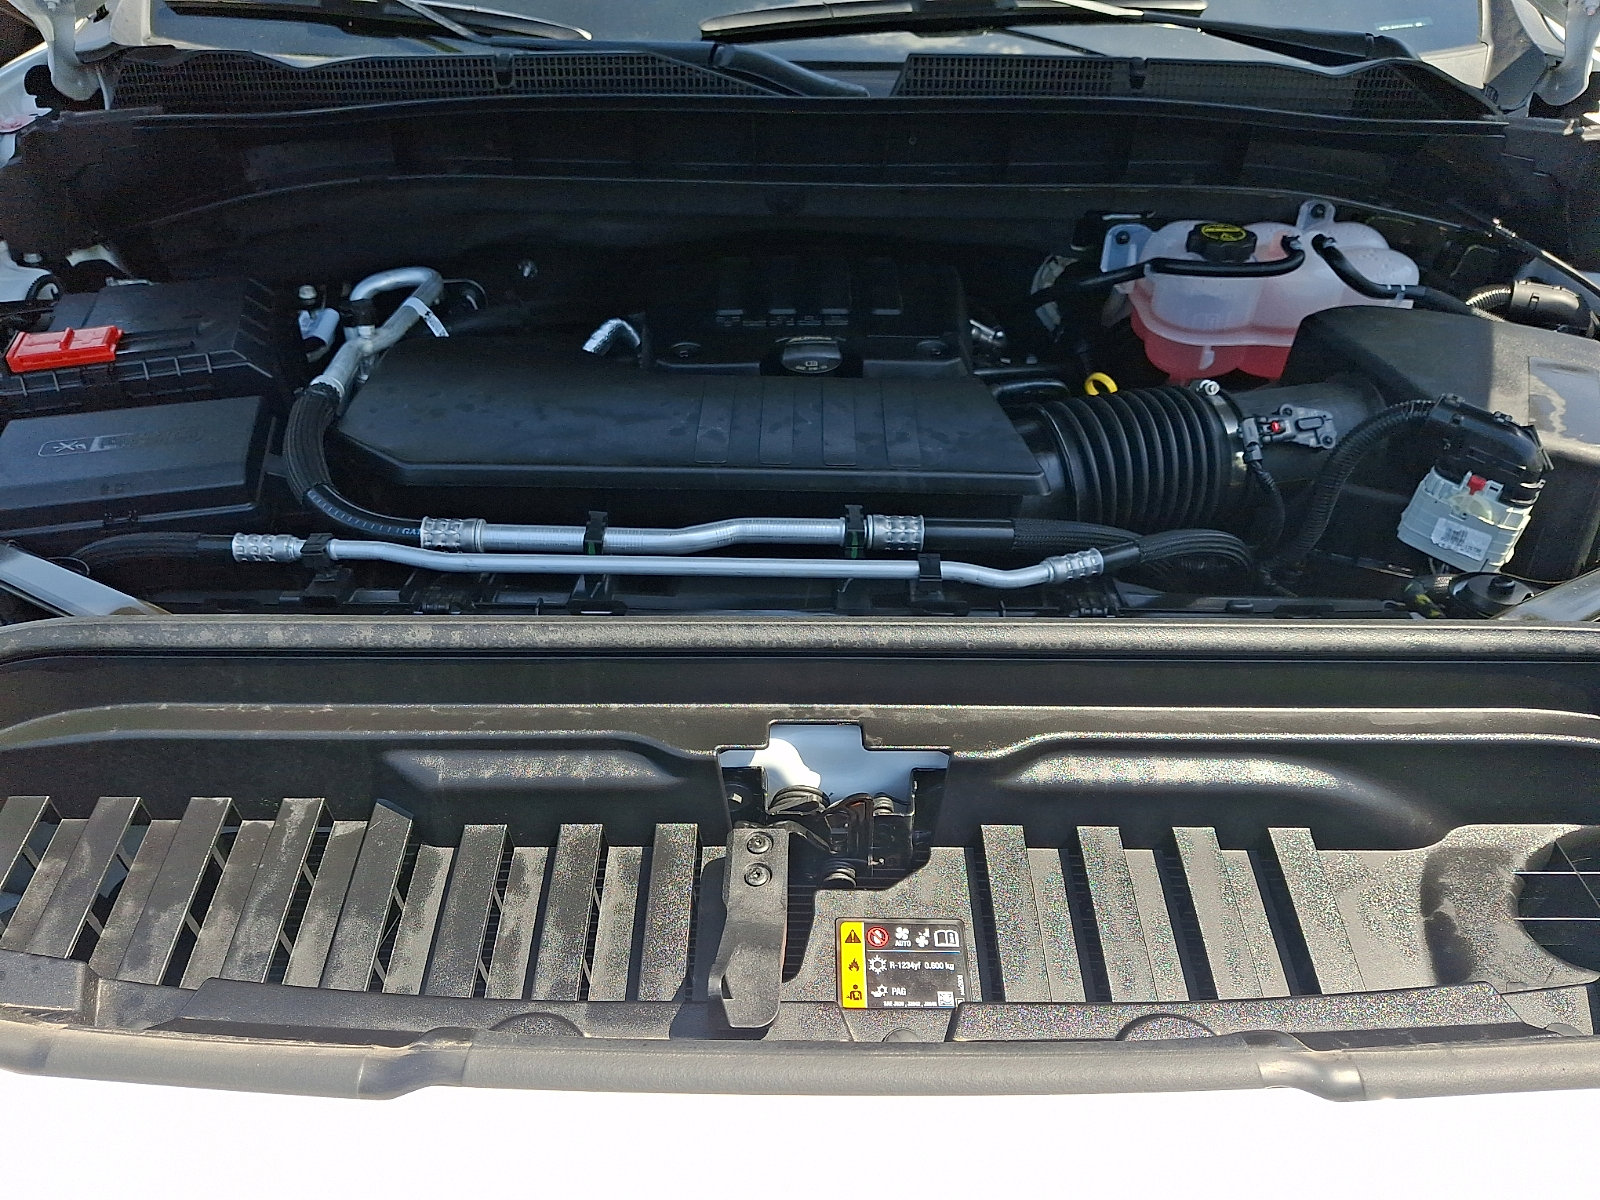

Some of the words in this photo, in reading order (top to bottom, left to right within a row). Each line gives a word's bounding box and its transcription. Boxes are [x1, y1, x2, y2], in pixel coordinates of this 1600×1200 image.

[889, 962, 921, 971] R-1234yf
[945, 962, 954, 971] kg
[891, 987, 907, 996] PAG
